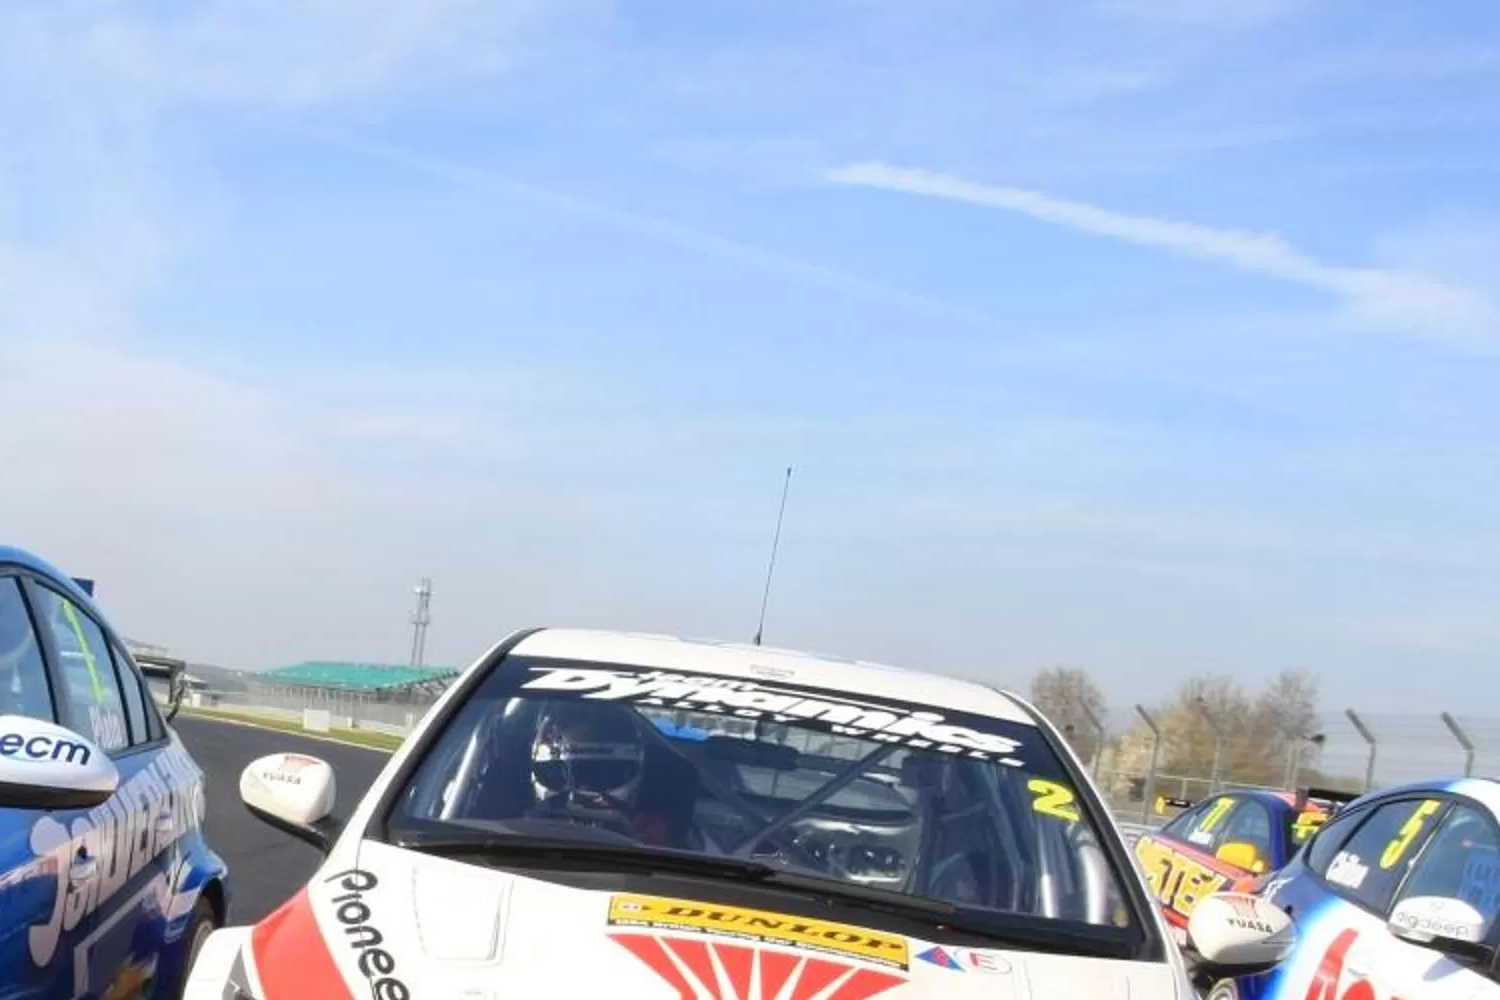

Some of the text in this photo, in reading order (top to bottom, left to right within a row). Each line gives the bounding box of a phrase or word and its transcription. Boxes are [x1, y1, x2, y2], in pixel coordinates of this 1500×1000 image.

[1027, 779, 1080, 822] 2
[662, 905, 904, 952] DUNLOP
[1228, 917, 1275, 934] YUASA
